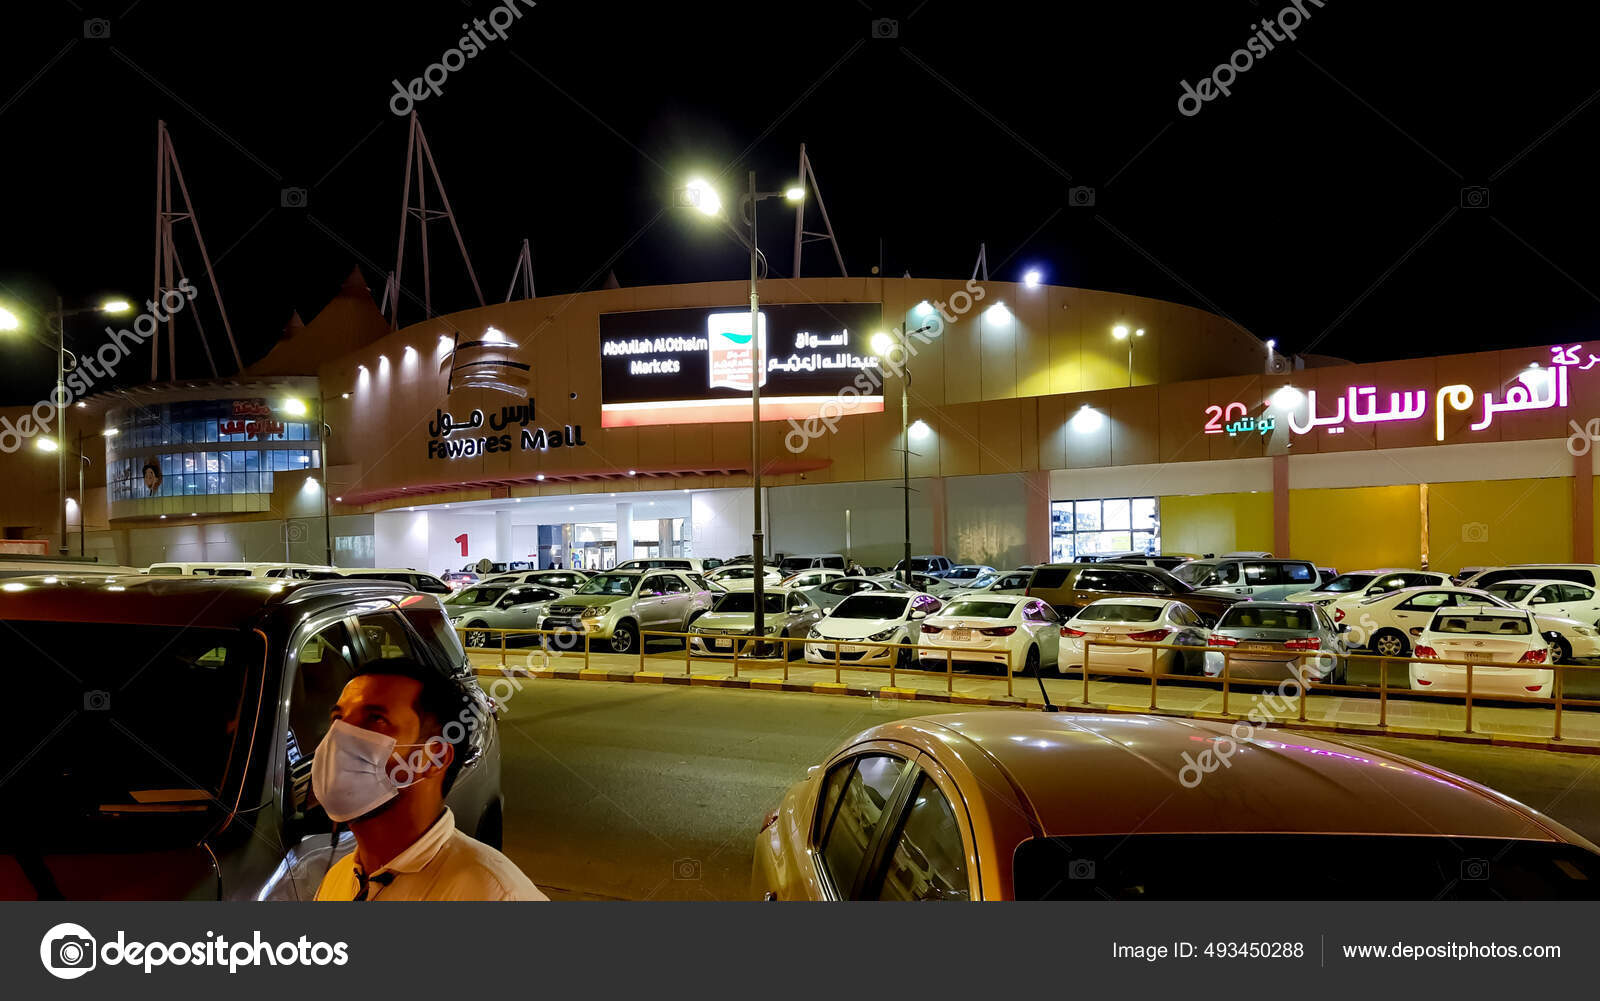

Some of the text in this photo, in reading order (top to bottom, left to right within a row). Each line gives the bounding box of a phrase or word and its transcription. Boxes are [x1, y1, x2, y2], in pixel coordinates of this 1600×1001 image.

[631, 359, 680, 375] Markets
[1550, 344, 1600, 370] ركة
[1287, 386, 1426, 435] ستايل
[427, 425, 587, 460] Fawares Mall
[454, 533, 469, 557] 1
